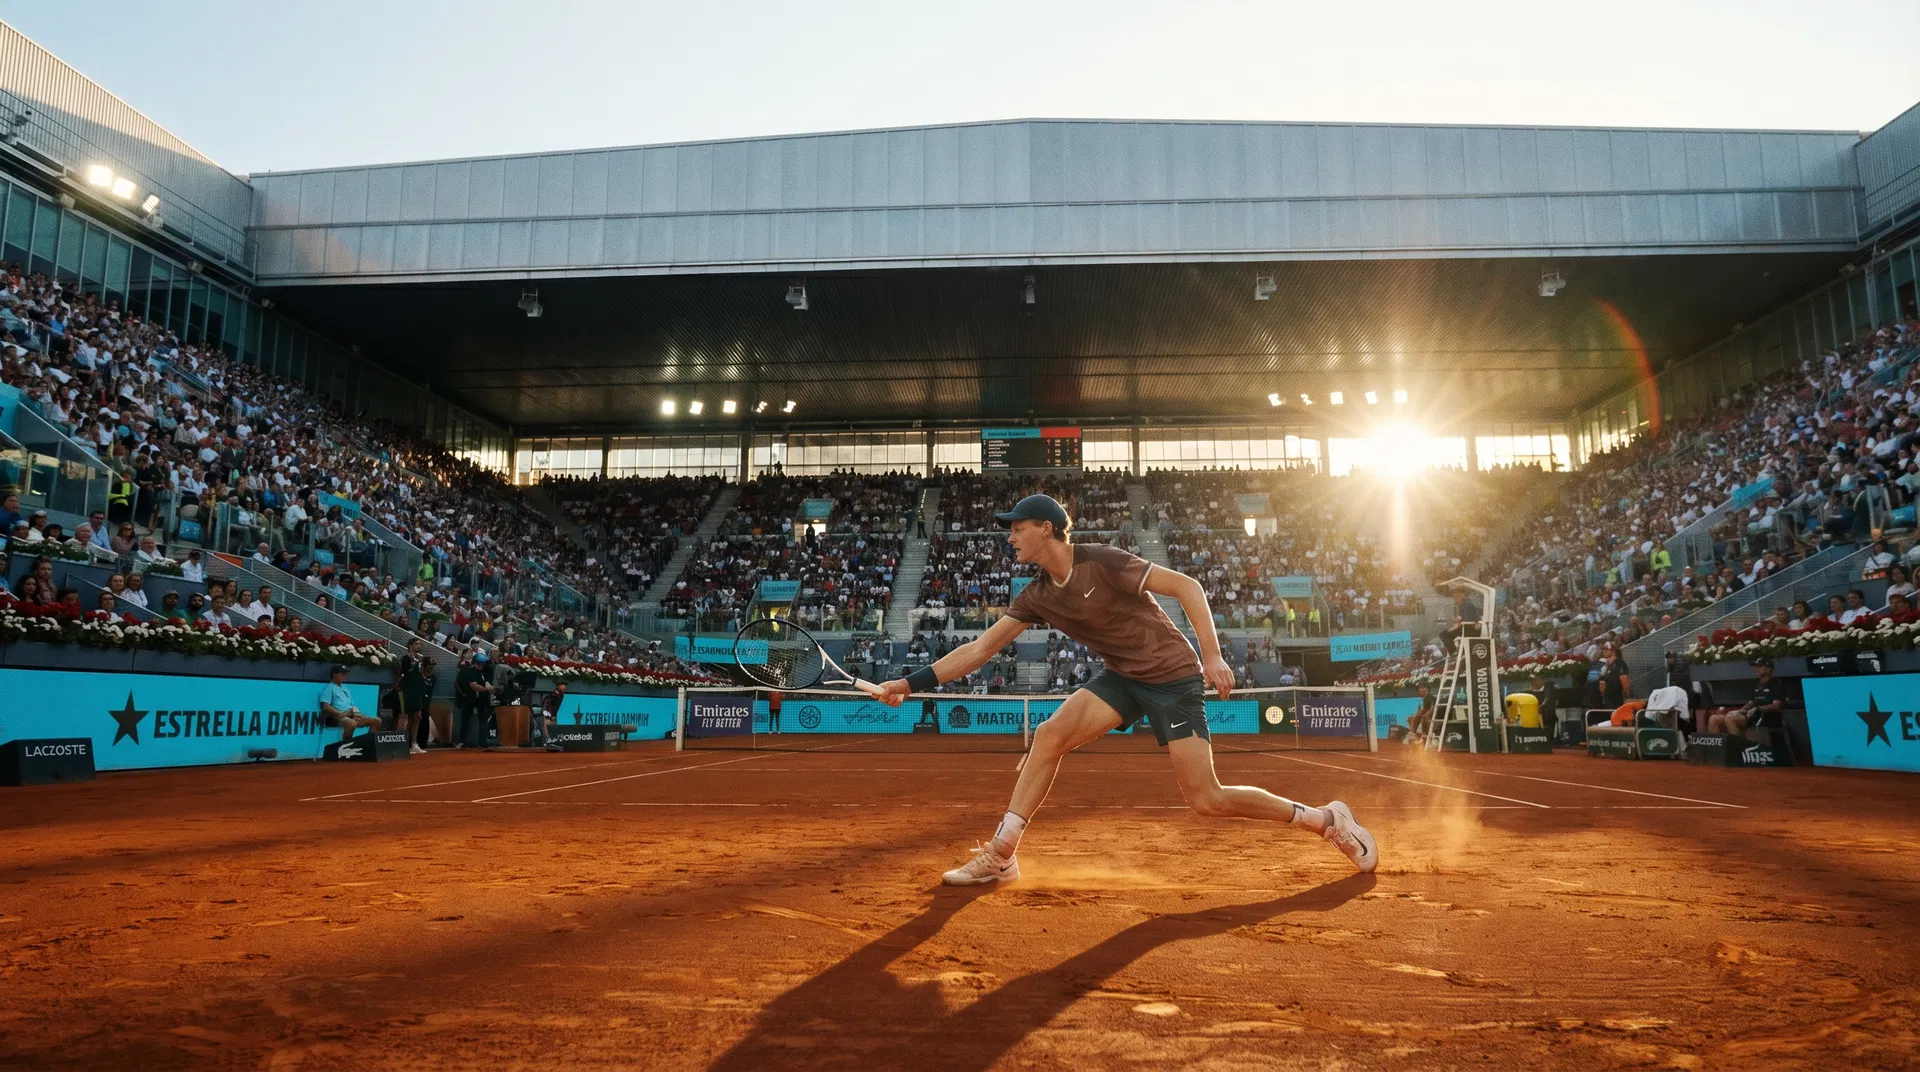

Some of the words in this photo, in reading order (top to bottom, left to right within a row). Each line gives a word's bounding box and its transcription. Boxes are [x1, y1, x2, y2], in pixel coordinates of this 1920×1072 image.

[694, 704, 749, 717] Emirates
[1302, 704, 1358, 717] Emirates
[153, 710, 262, 739] ESTRELLA
[266, 711, 325, 736] DAMM
[702, 718, 715, 728] FLY
[715, 718, 742, 728] BETTER
[1310, 717, 1323, 728] FLY
[1324, 717, 1351, 728] BETTER
[25, 744, 87, 757] LACZOSTE
